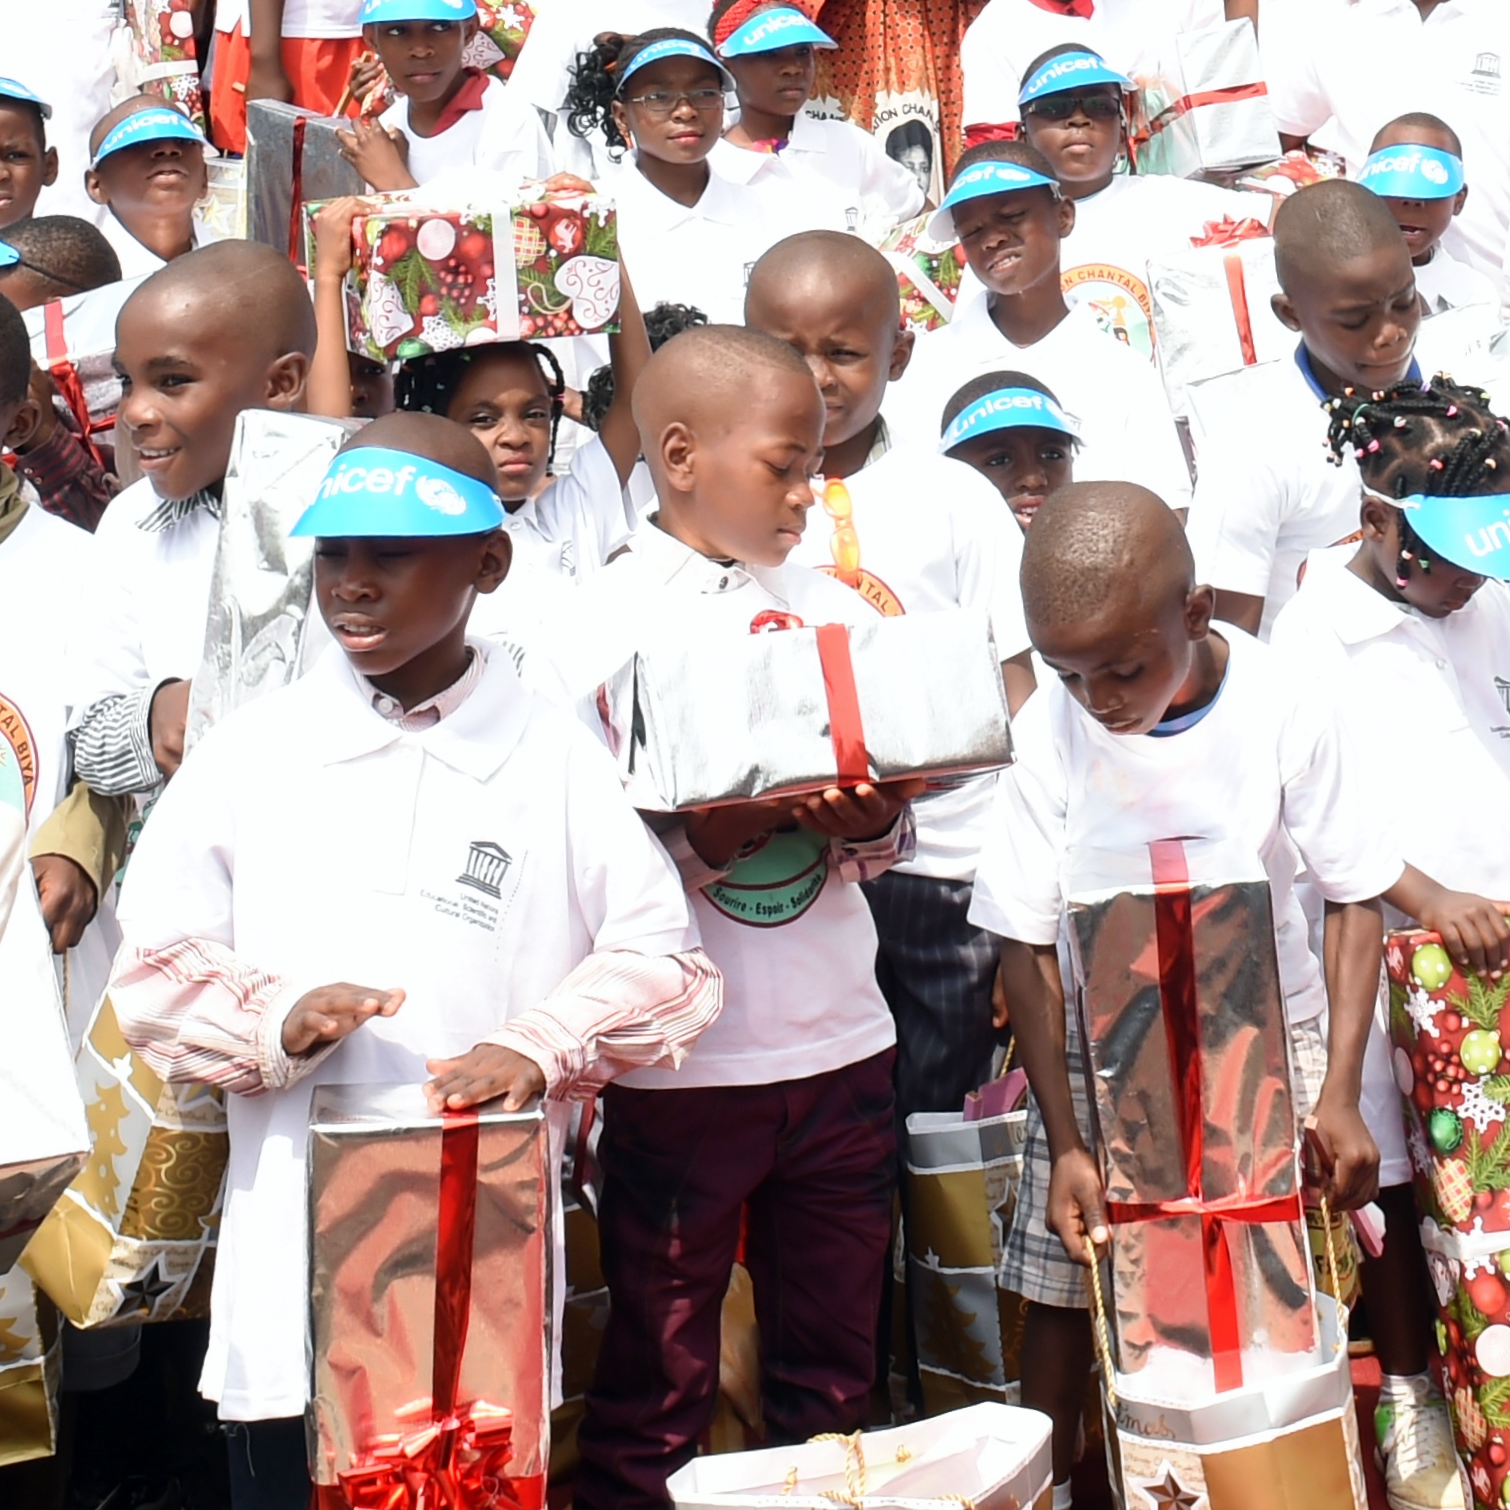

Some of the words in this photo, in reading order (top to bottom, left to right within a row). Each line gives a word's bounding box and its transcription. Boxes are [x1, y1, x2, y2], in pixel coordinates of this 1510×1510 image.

[1056, 270, 1137, 296] CHANTAL
[318, 464, 418, 500] nicef
[16, 740, 35, 787] BIYA
[712, 885, 747, 914] Sourire
[755, 901, 784, 919] Espoir
[791, 872, 824, 910] Solidarité
